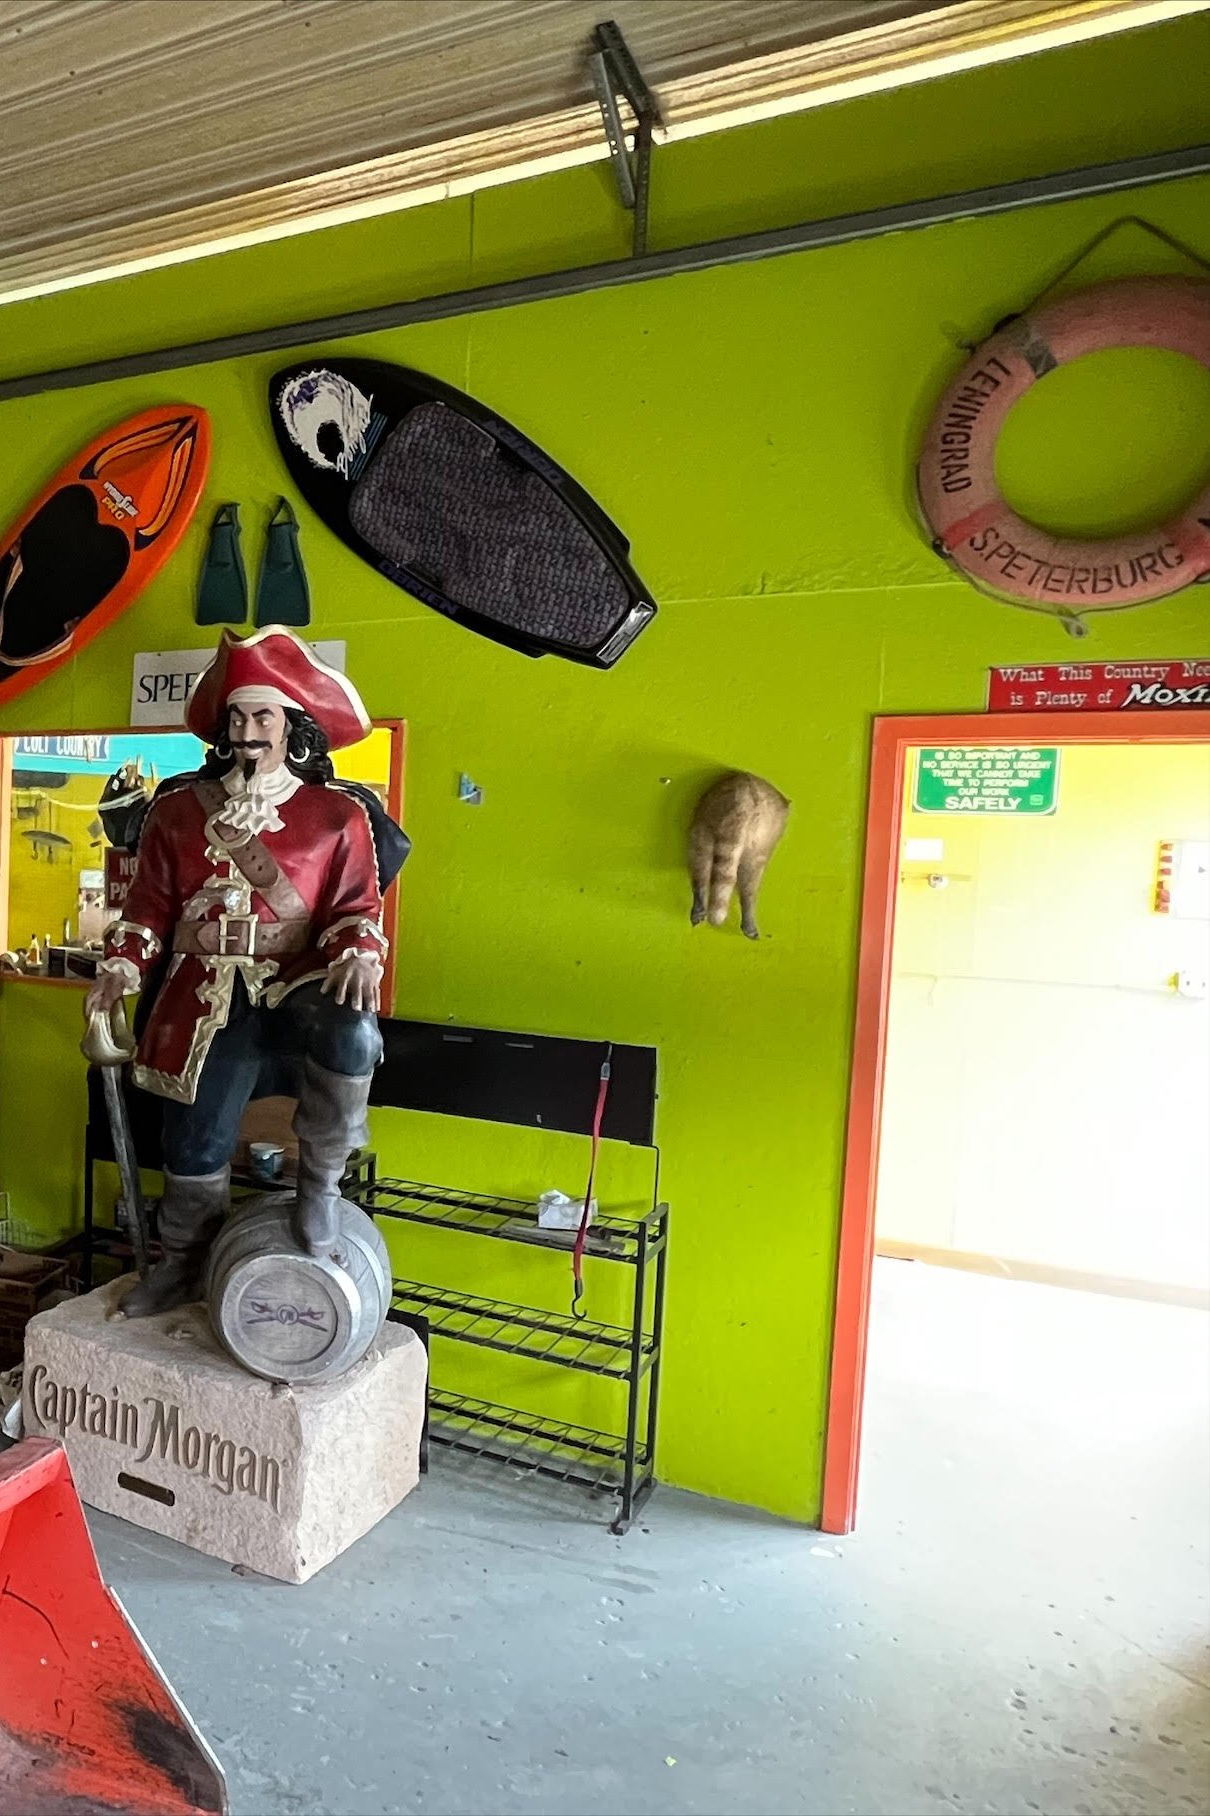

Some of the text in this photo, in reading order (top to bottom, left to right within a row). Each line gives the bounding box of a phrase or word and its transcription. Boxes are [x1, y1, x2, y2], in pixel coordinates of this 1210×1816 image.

[940, 356, 1012, 494] LENINGRAD
[101, 496, 126, 521] PRO
[998, 661, 1210, 683] What This Country Nee
[1009, 691, 1025, 706] is
[1034, 690, 1088, 708] Plenty
[1097, 688, 1114, 704] of
[944, 796, 1023, 810] SAFELY
[28, 1364, 281, 1514] Captain Morgan
